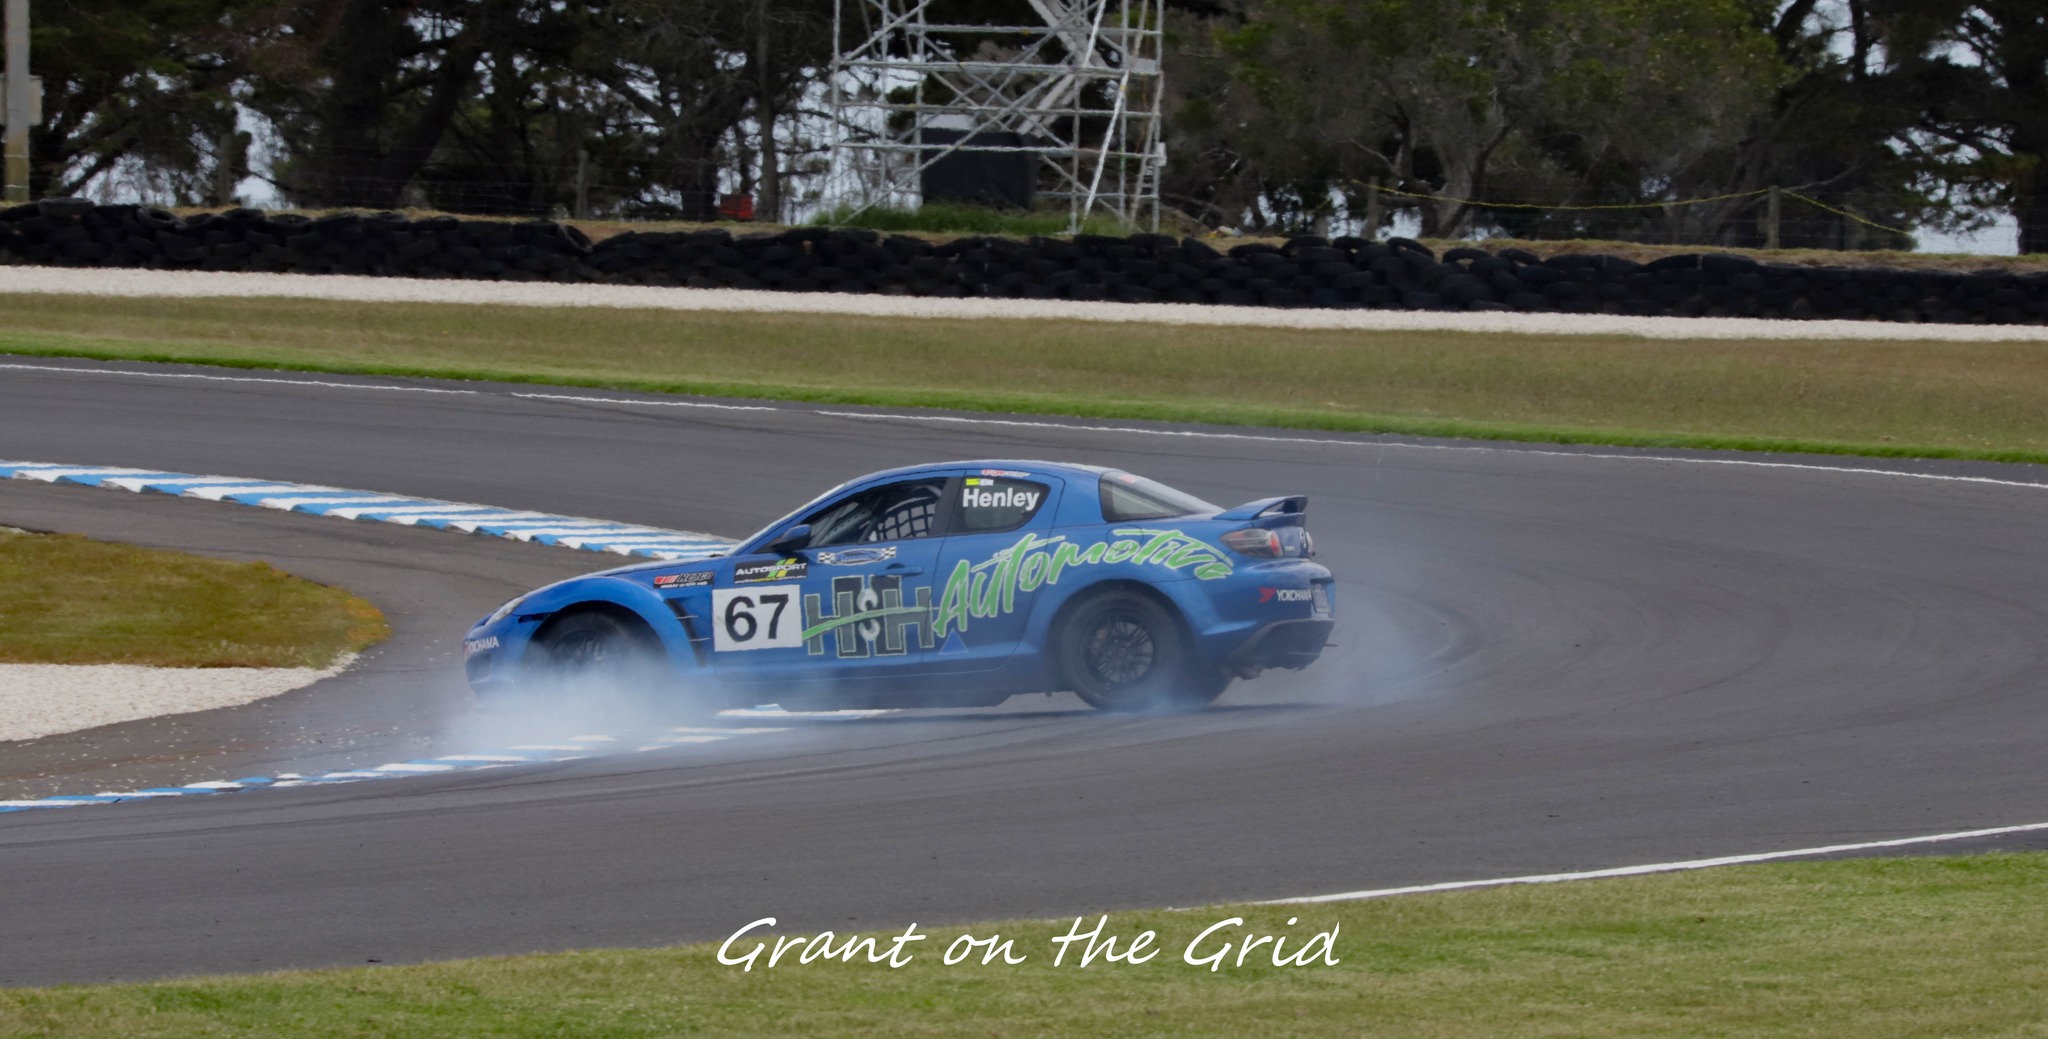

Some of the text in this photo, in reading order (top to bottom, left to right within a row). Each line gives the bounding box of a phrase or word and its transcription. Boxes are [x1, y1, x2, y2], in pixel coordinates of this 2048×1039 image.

[962, 487, 1040, 512] Henley
[735, 563, 807, 575] AUTOSPORT
[932, 529, 1234, 638] Automotive
[1277, 589, 1312, 602] YOKOHAMA
[725, 594, 790, 642] 67
